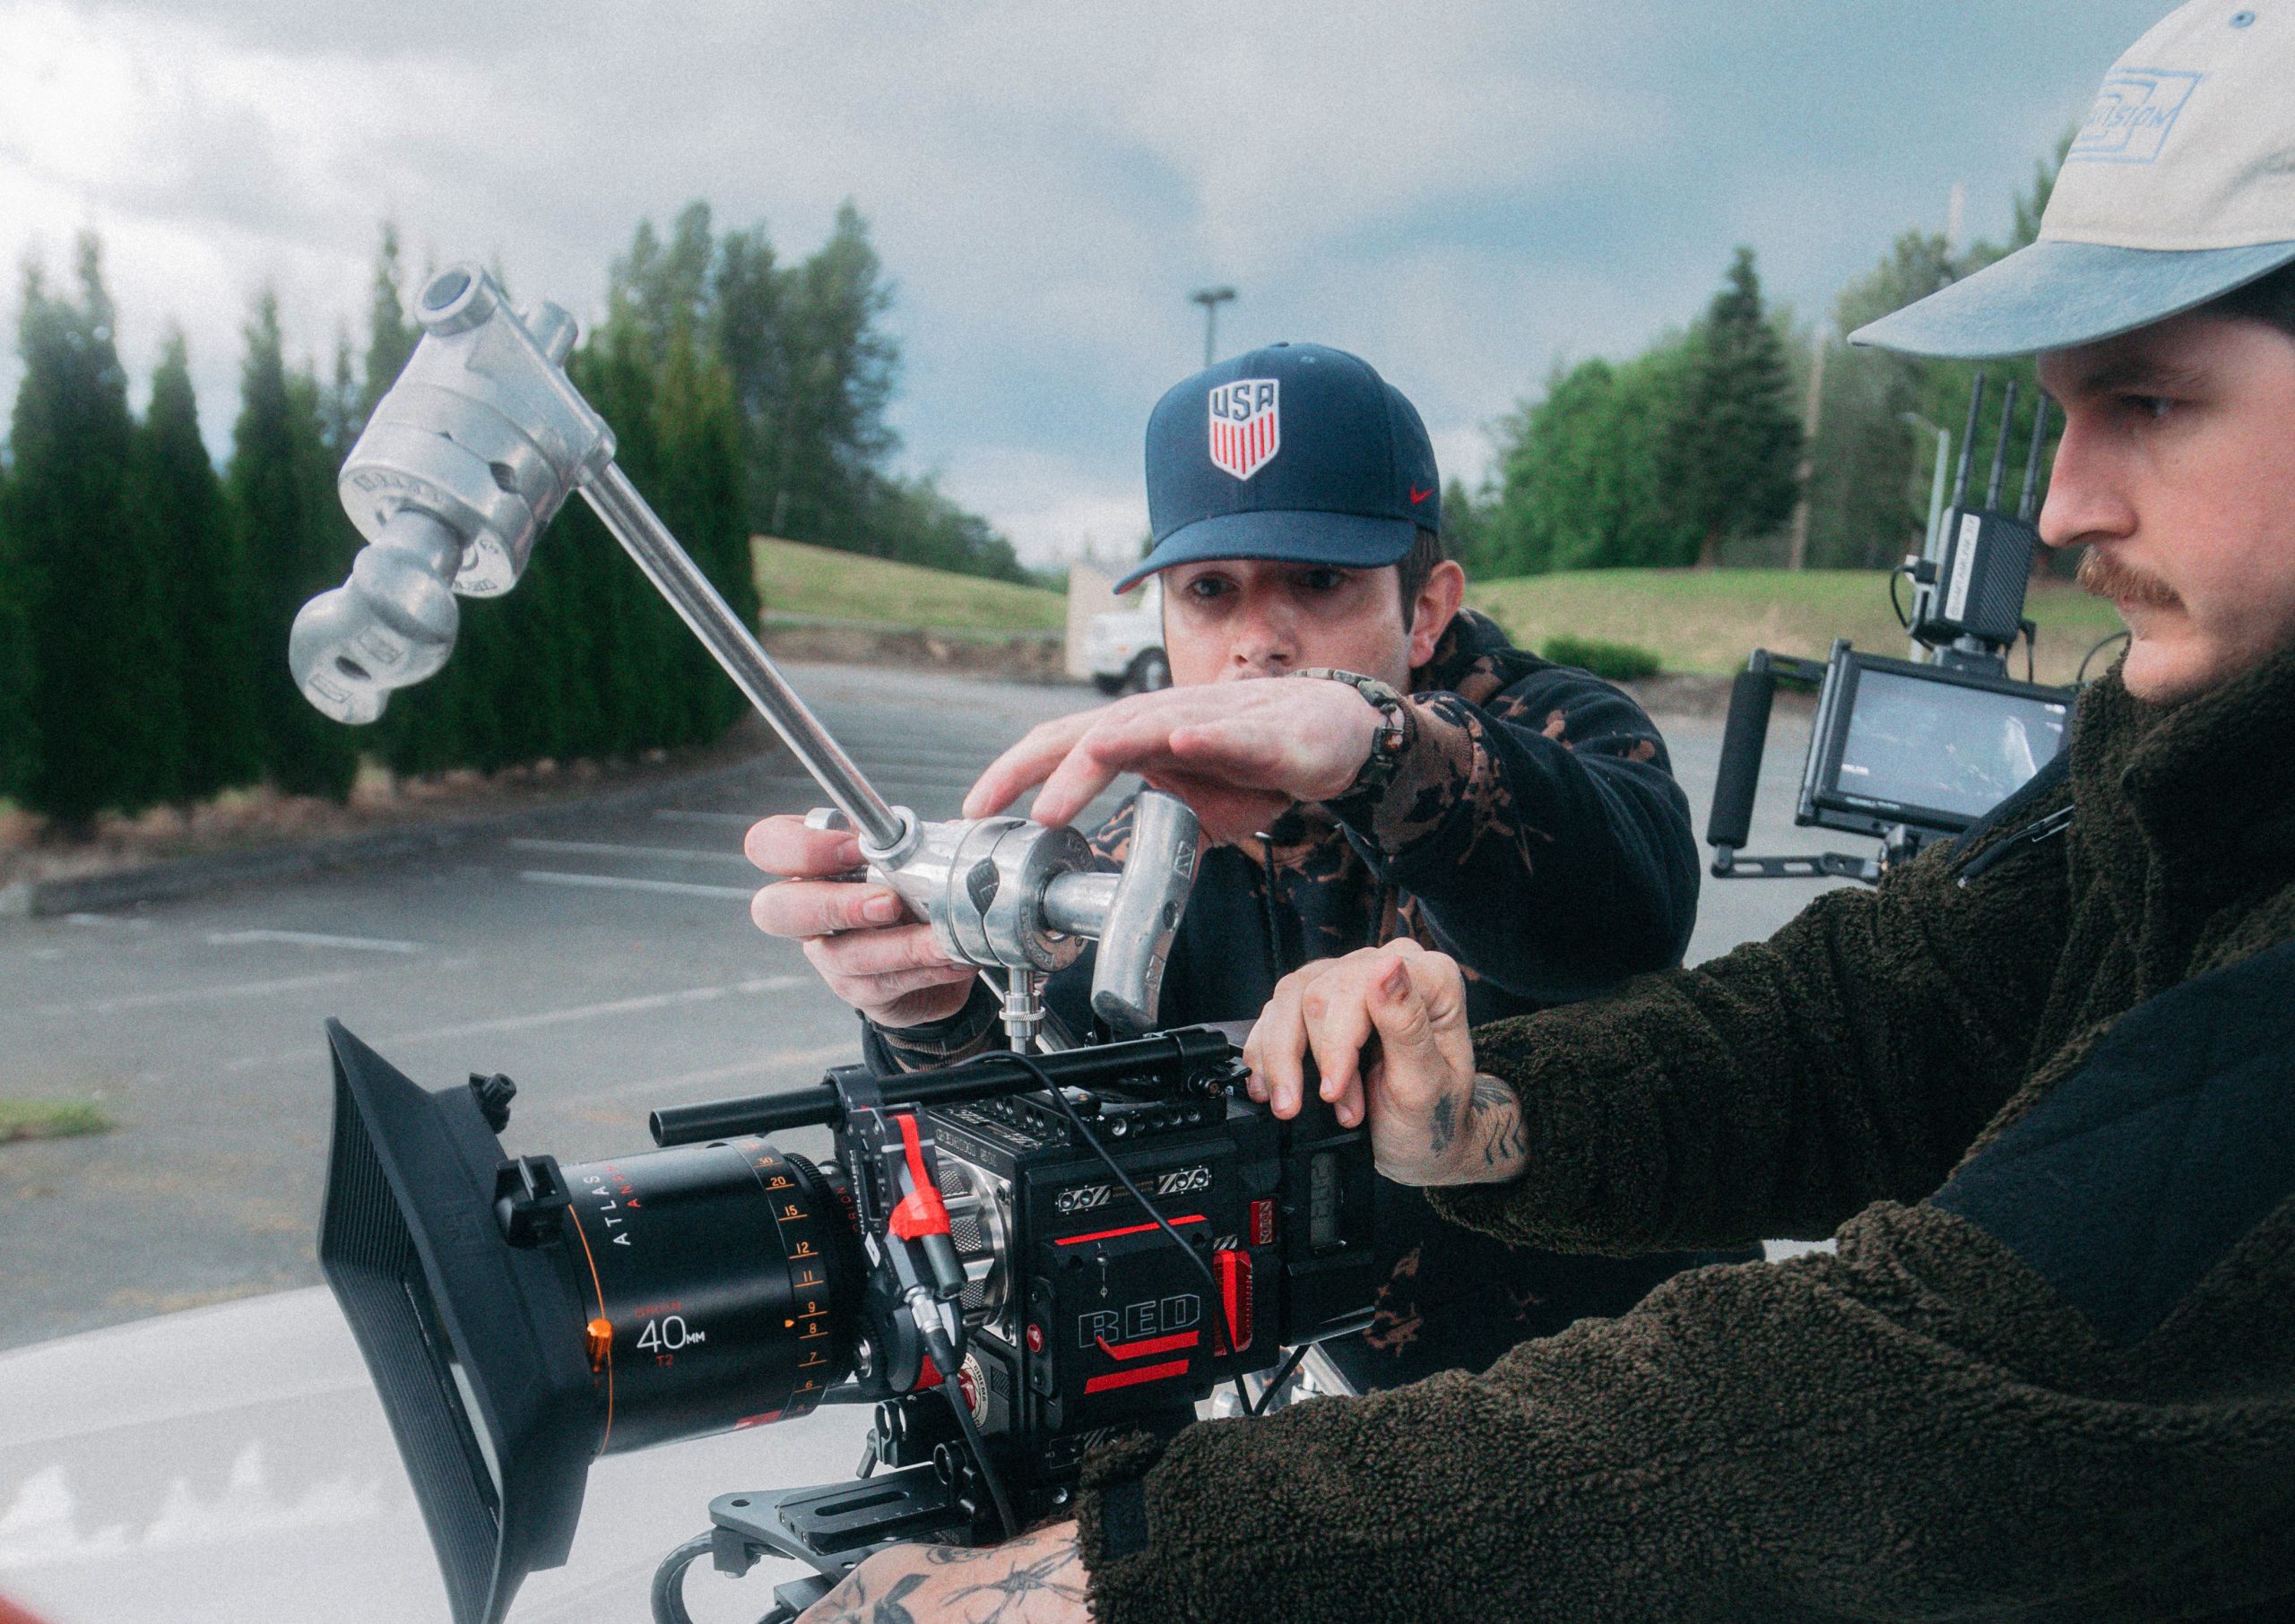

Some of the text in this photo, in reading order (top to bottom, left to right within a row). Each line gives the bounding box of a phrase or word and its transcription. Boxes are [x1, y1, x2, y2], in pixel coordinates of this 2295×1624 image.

[1213, 383, 1274, 421] USA
[770, 1176, 786, 1187] 20
[849, 1149, 866, 1235] NUCLEUS-M
[583, 1175, 631, 1246] ATLAS
[784, 1205, 798, 1216] 15
[796, 1241, 810, 1255] 12
[803, 1269, 813, 1283] 11
[808, 1301, 816, 1313] 9
[1078, 1293, 1200, 1348] RED
[810, 1322, 817, 1334] 8
[655, 1354, 674, 1367] T2
[810, 1351, 817, 1362] 7
[974, 1365, 987, 1402] CINEMA
